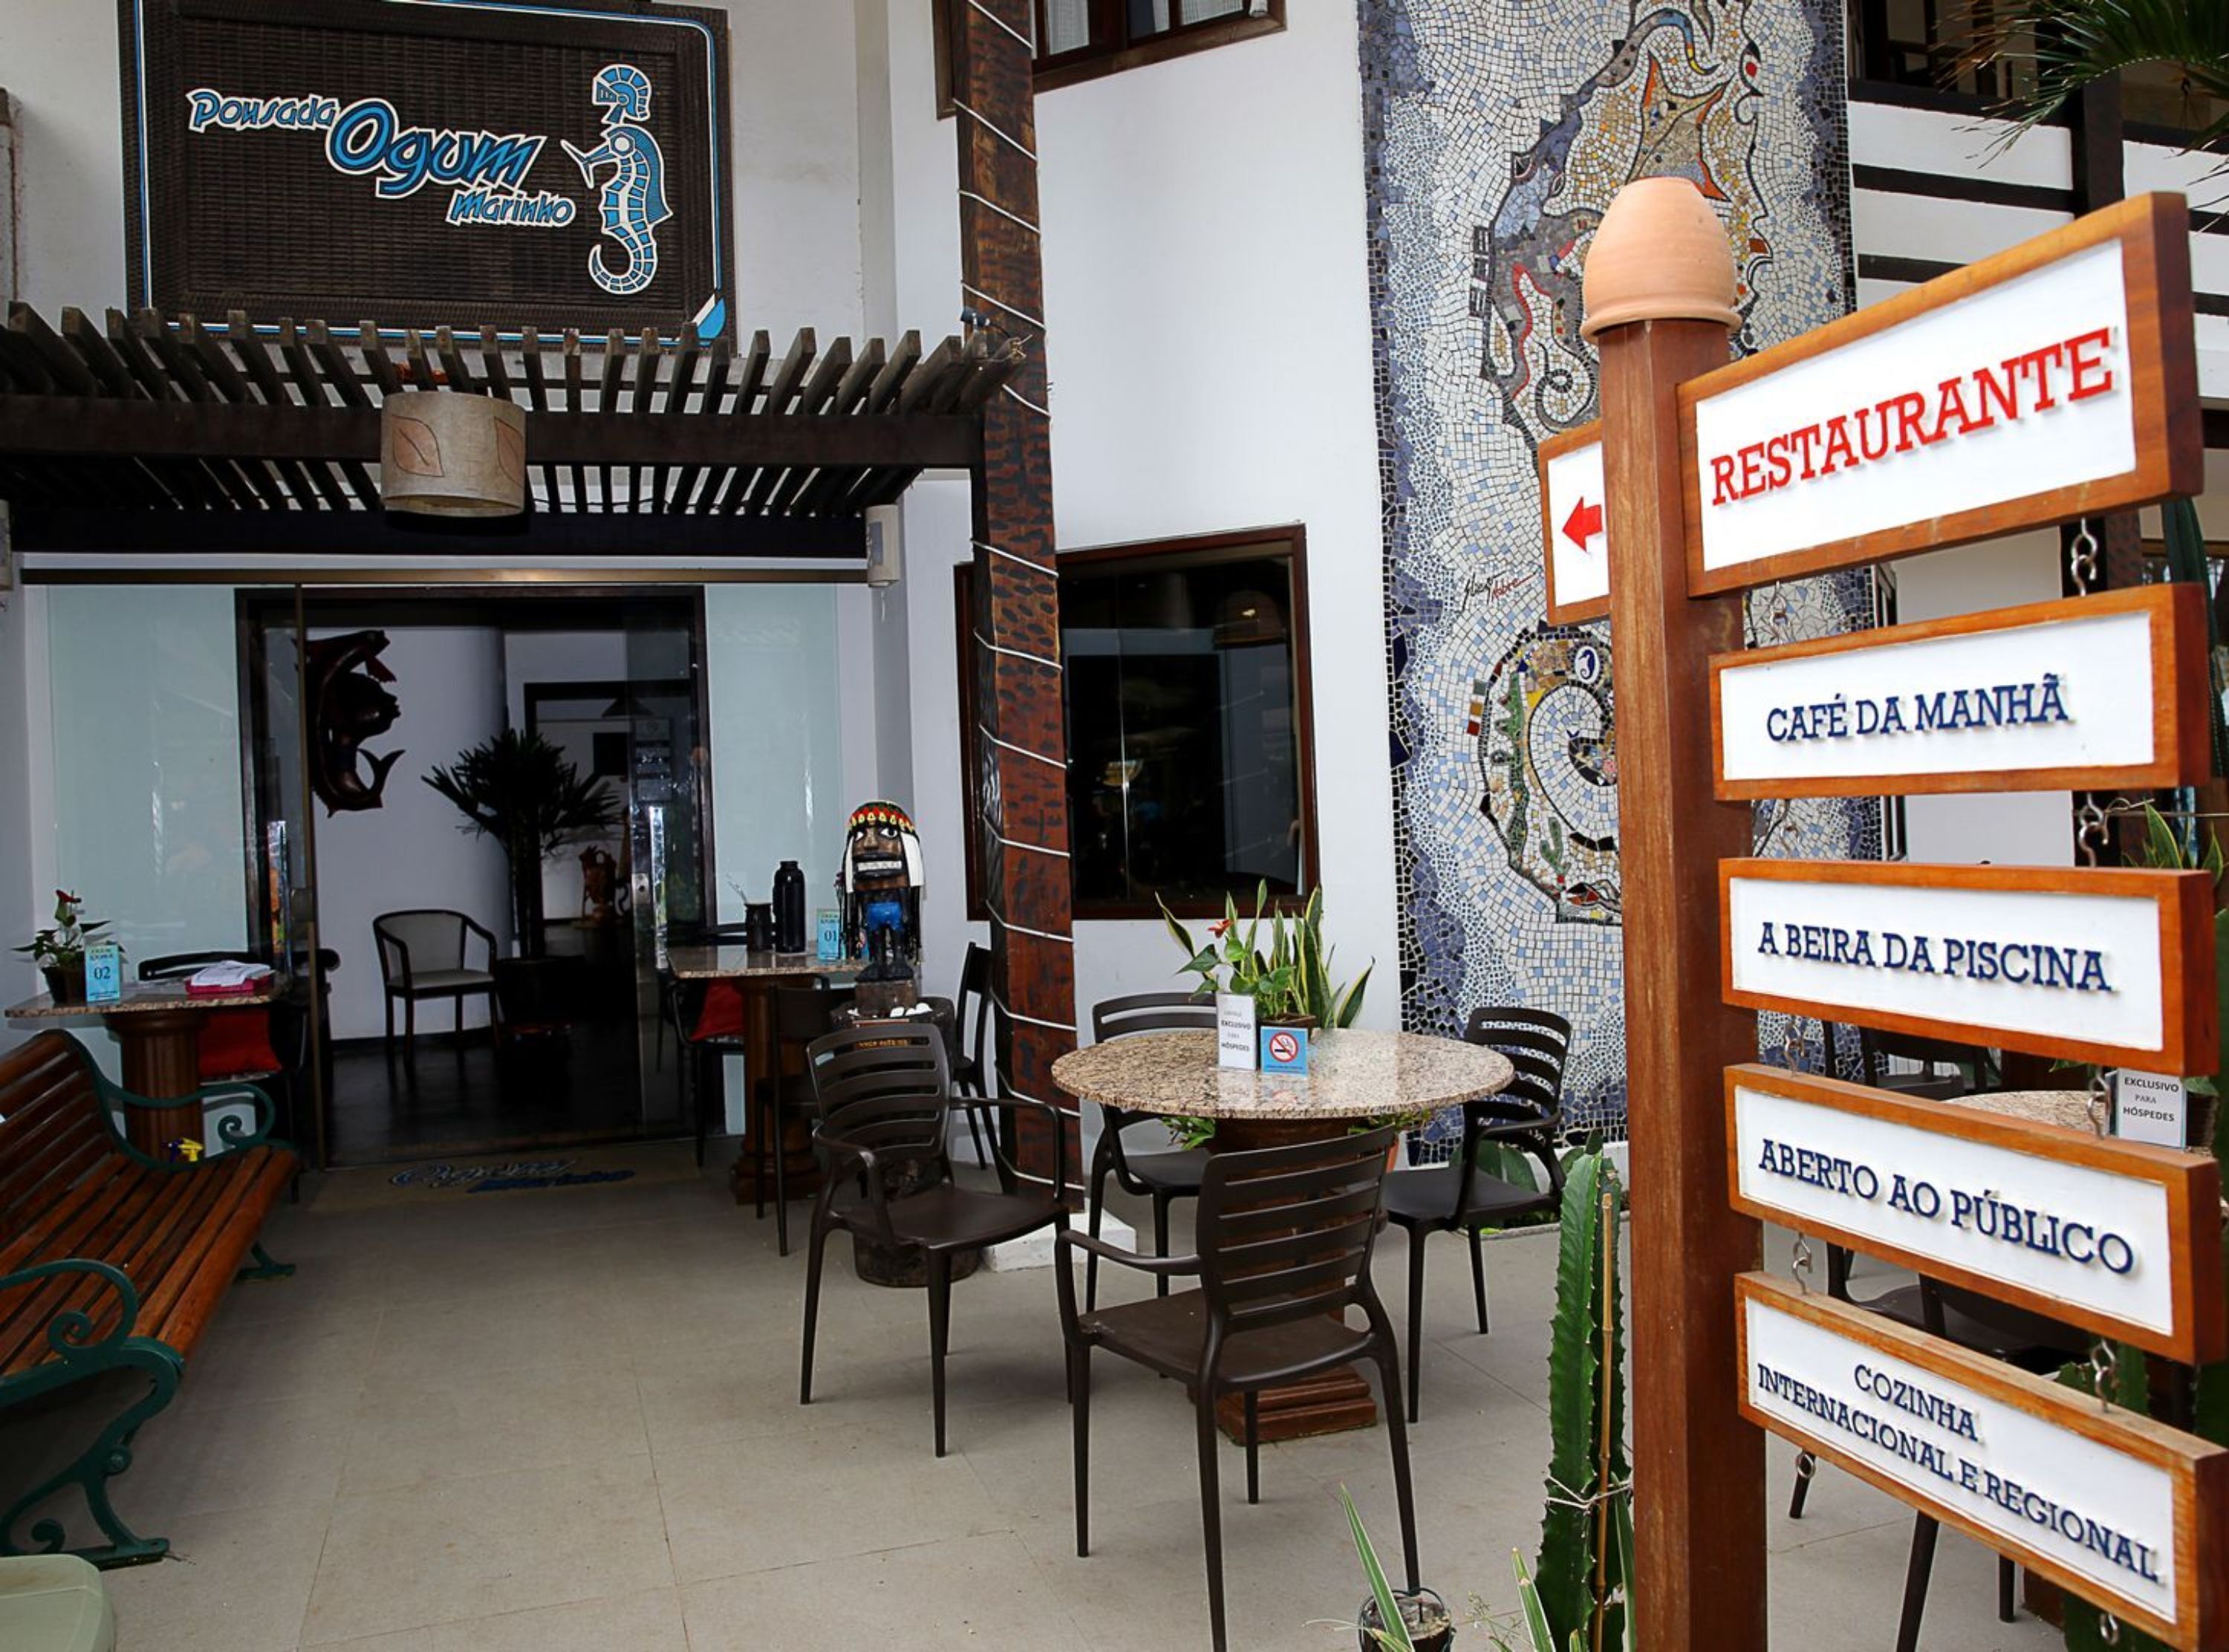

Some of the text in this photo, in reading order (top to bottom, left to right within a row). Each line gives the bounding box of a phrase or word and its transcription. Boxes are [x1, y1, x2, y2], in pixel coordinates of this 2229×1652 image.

[189, 89, 340, 131] Pousada
[327, 98, 545, 198] Ogum
[1711, 327, 2112, 506] RESTAURANTE
[1767, 673, 2069, 743] CAFÉ DA MANHÃ
[94, 966, 111, 980] 02
[1758, 922, 2112, 993] A BEIRA DA PISCINA
[2123, 1107, 2174, 1122] HÓSPEDES
[2124, 1076, 2178, 1093] EXCLUSIVO
[2135, 1093, 2157, 1105] PARA
[1759, 1139, 2135, 1275] ABERTO AO PÚBLICO
[1854, 1364, 1979, 1443] COZINHA
[1758, 1362, 2161, 1584] INTERNACIONAL E REGIONAL
